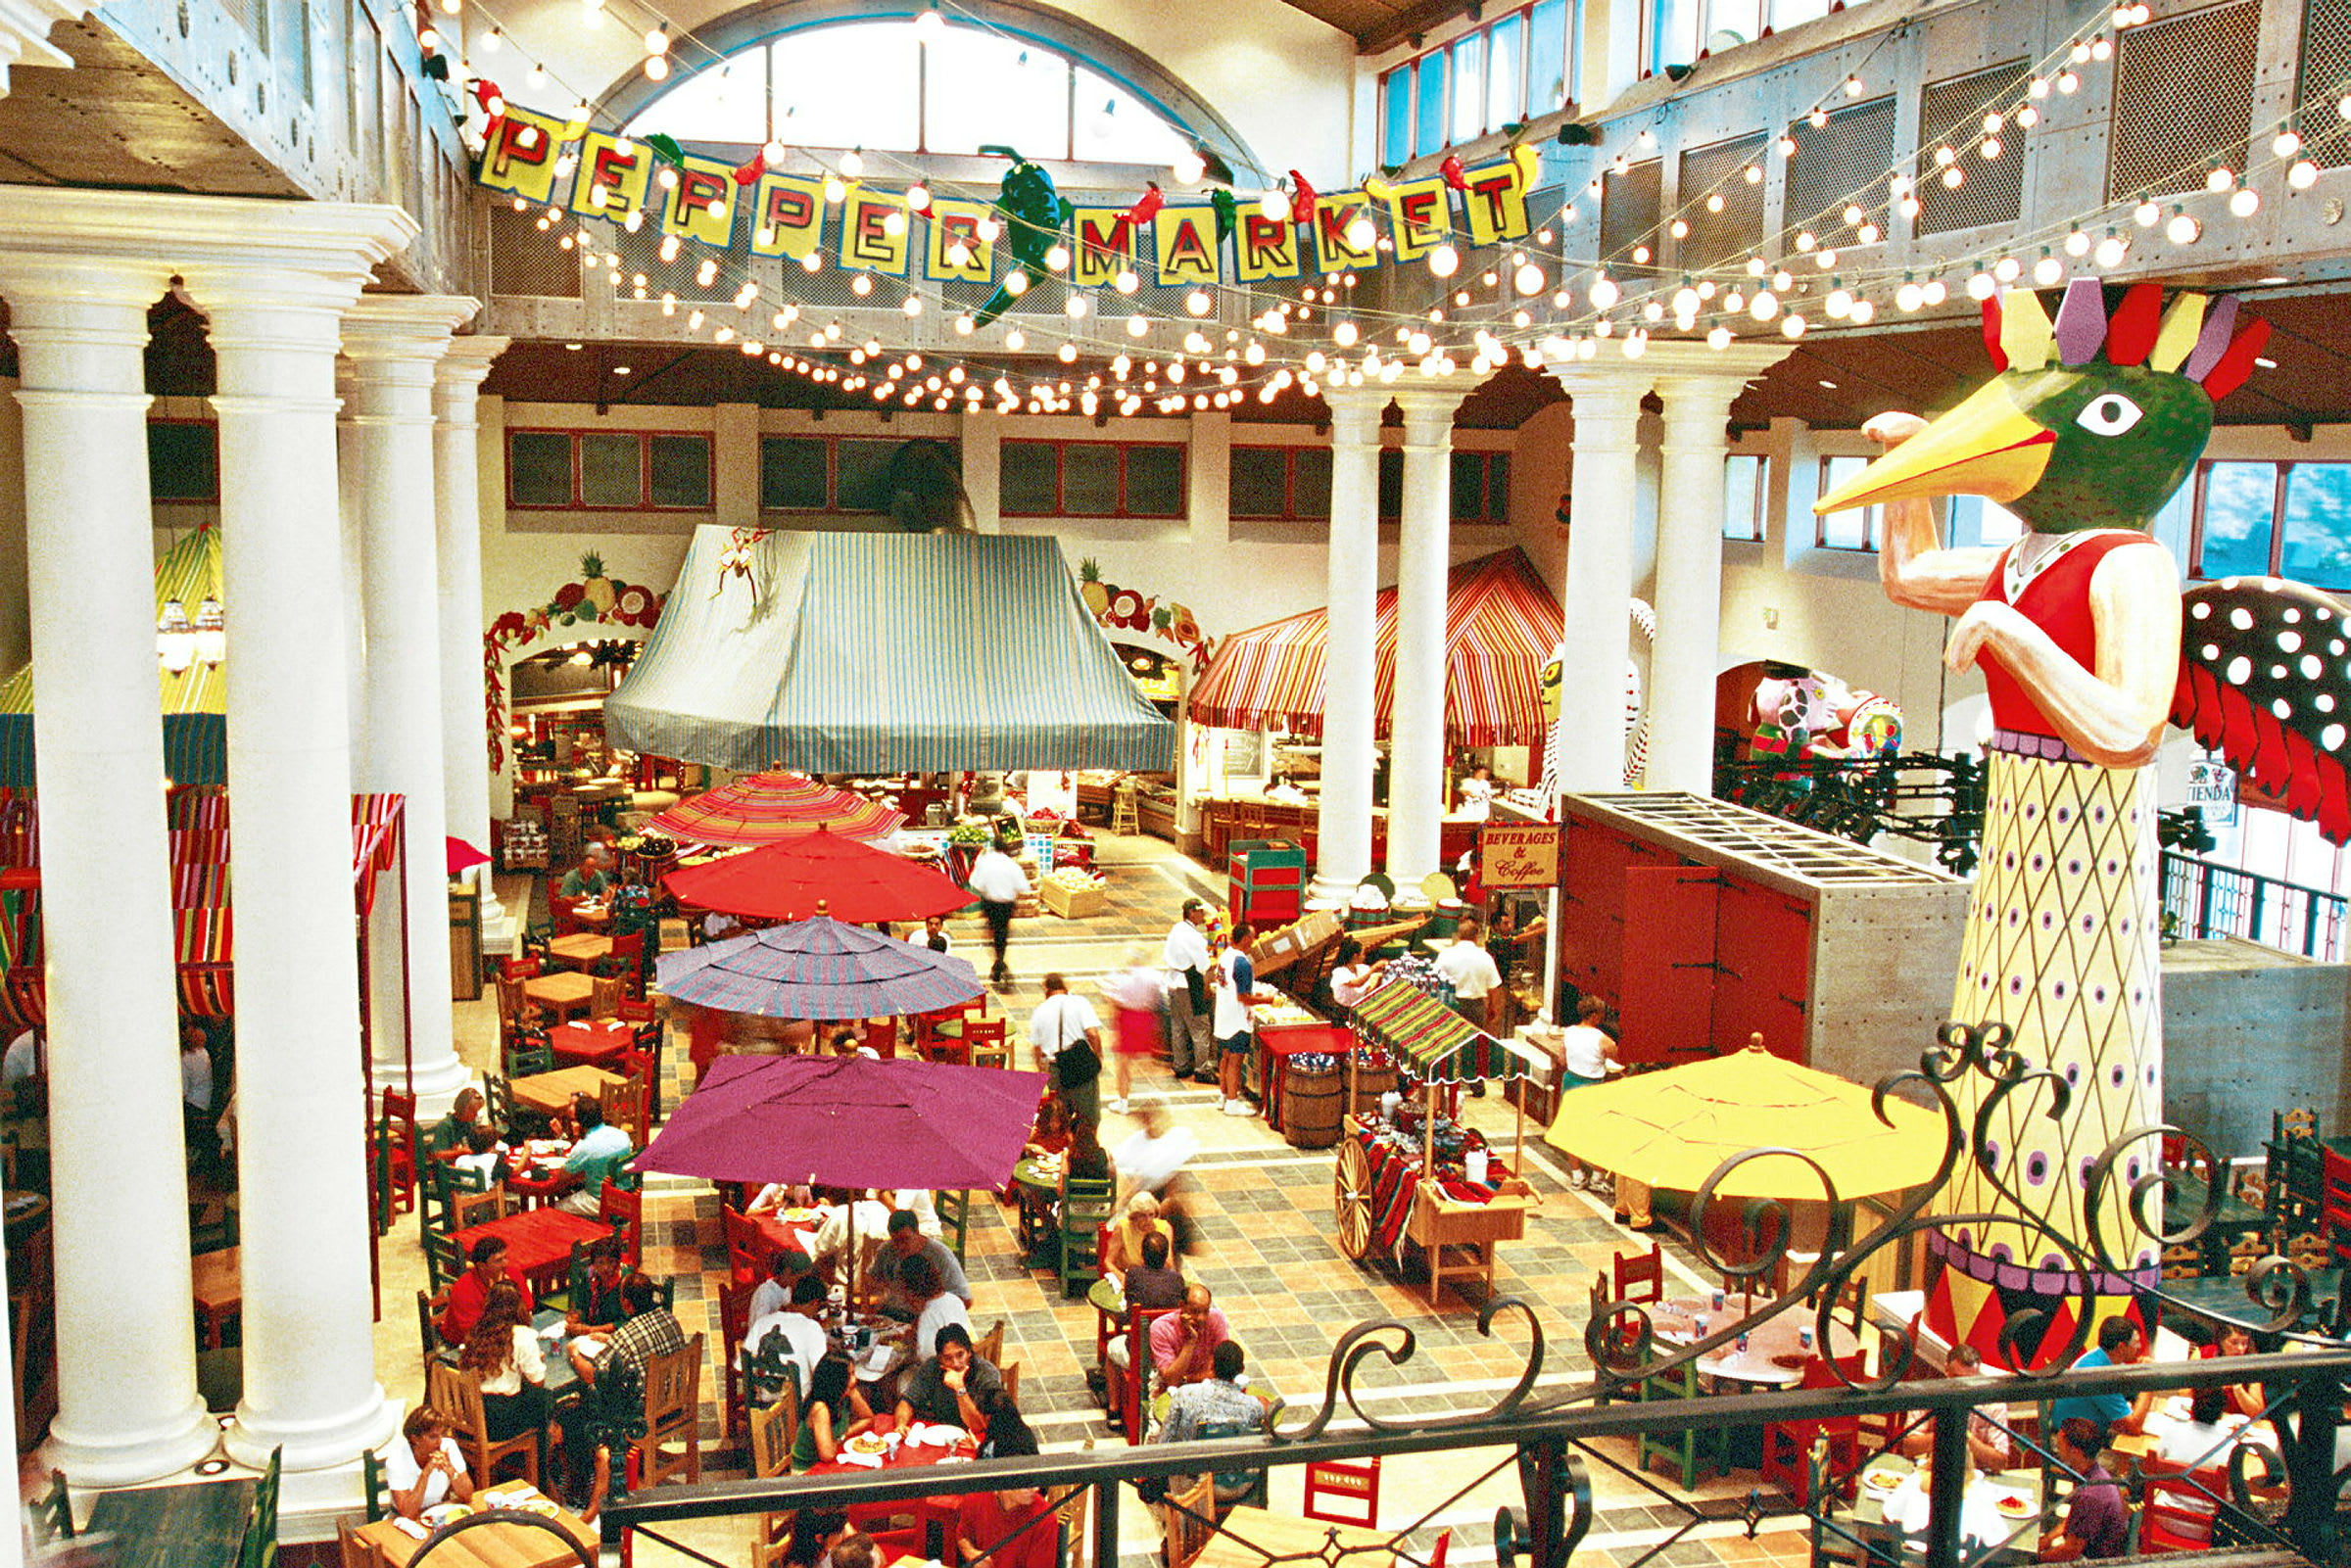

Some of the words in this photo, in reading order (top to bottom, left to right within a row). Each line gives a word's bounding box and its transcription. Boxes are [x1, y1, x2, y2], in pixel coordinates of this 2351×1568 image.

[492, 117, 985, 271] PEPPER
[1080, 174, 1513, 276] MARKET
[1485, 832, 1557, 845] BEVERAGES
[1513, 846, 1527, 859] &
[1495, 860, 1545, 881] Coffee
